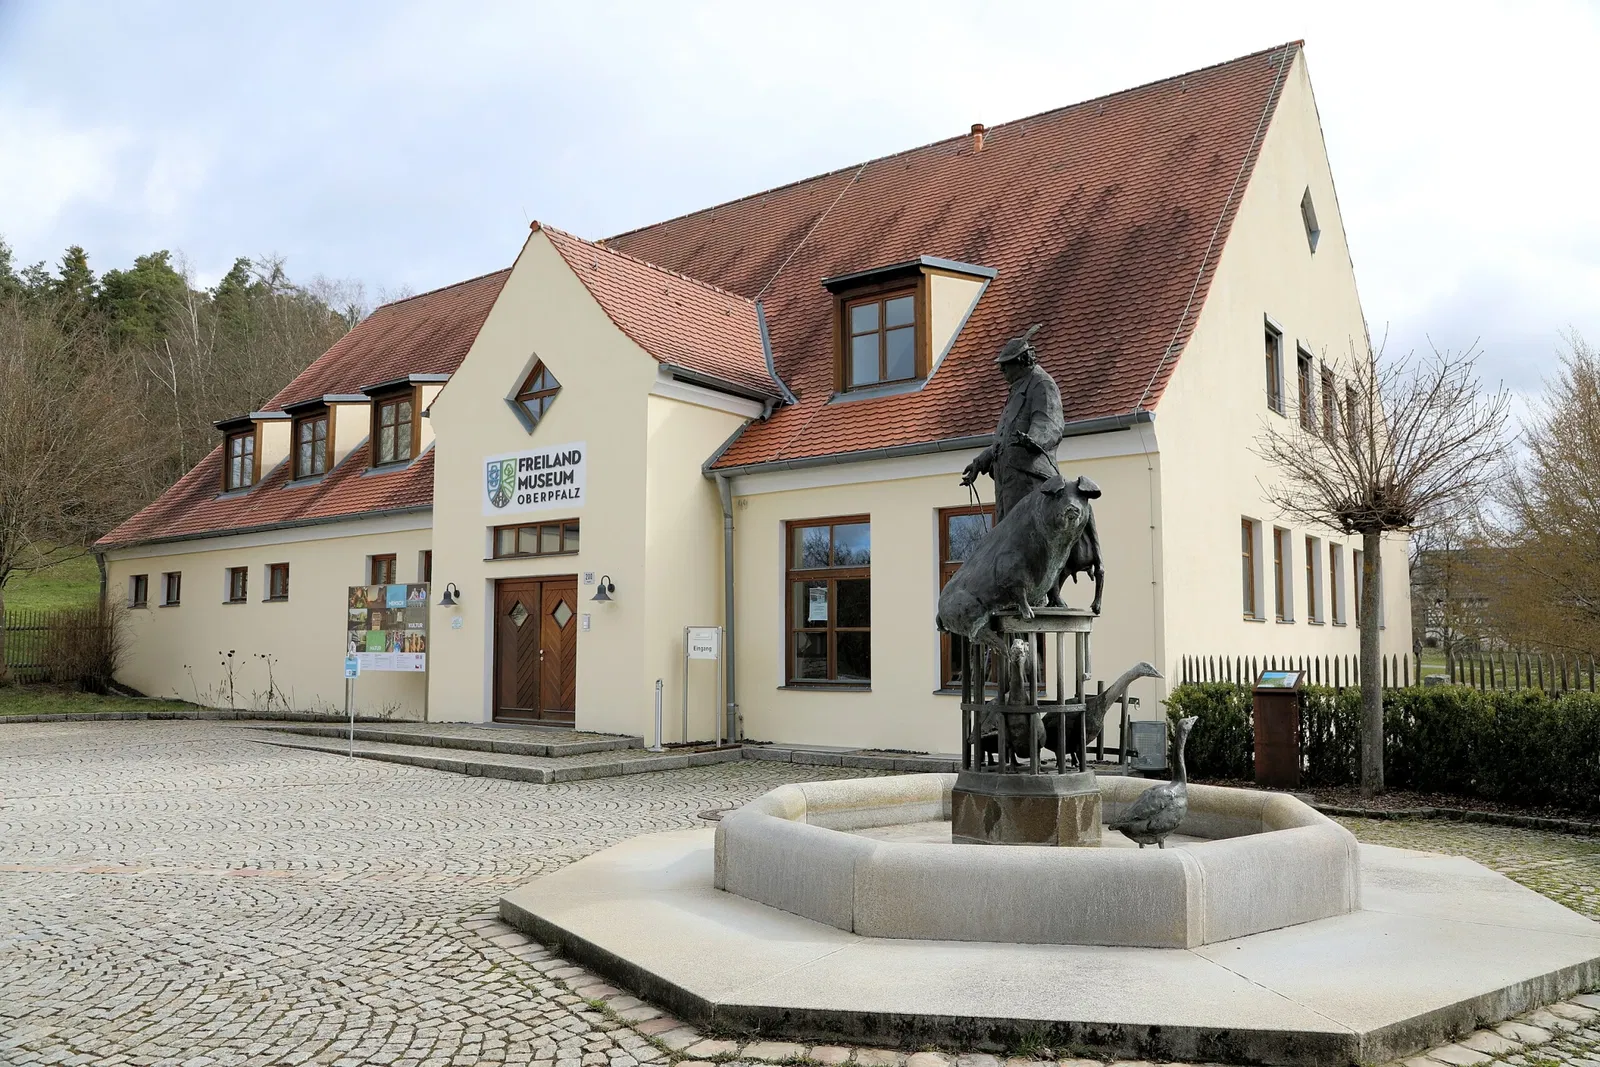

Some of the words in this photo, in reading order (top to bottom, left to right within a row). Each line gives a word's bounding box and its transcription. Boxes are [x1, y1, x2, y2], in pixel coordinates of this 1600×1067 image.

[518, 450, 582, 472] FREILAND
[518, 469, 574, 490] MUSEUM
[517, 488, 580, 505] OBERPFALZ
